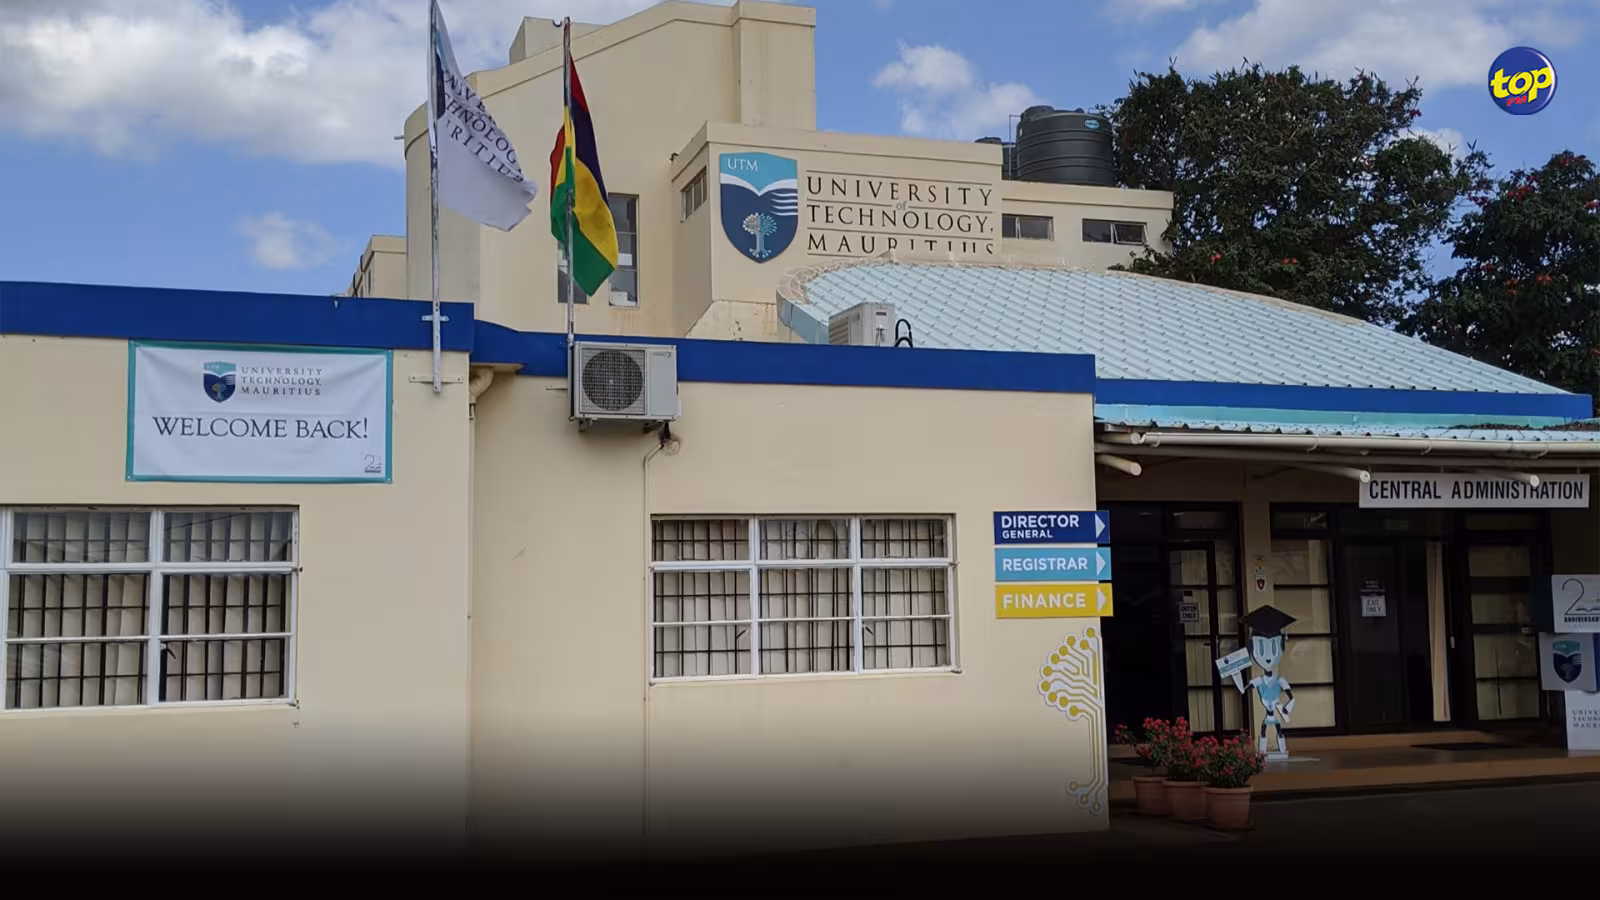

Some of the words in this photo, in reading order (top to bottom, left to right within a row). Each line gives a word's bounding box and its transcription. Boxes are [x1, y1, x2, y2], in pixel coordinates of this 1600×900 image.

[727, 158, 759, 171] UTM
[806, 176, 993, 206] UNIVERSITY
[896, 201, 909, 211] of
[806, 204, 994, 233] TECHNOLOGY,
[241, 366, 322, 376] UNIVERSITY
[241, 386, 321, 396] MAURITIUS
[152, 416, 288, 438] WELCOME
[295, 418, 368, 439] BACK!
[1369, 480, 1442, 500] CENTRAL
[1451, 480, 1584, 500] ADMINISTRATION
[1001, 515, 1080, 528] DIRECTOR
[1002, 530, 1053, 539] GENERAL
[1002, 557, 1088, 571] REGISTRAR
[1003, 592, 1087, 609] FINANCE
